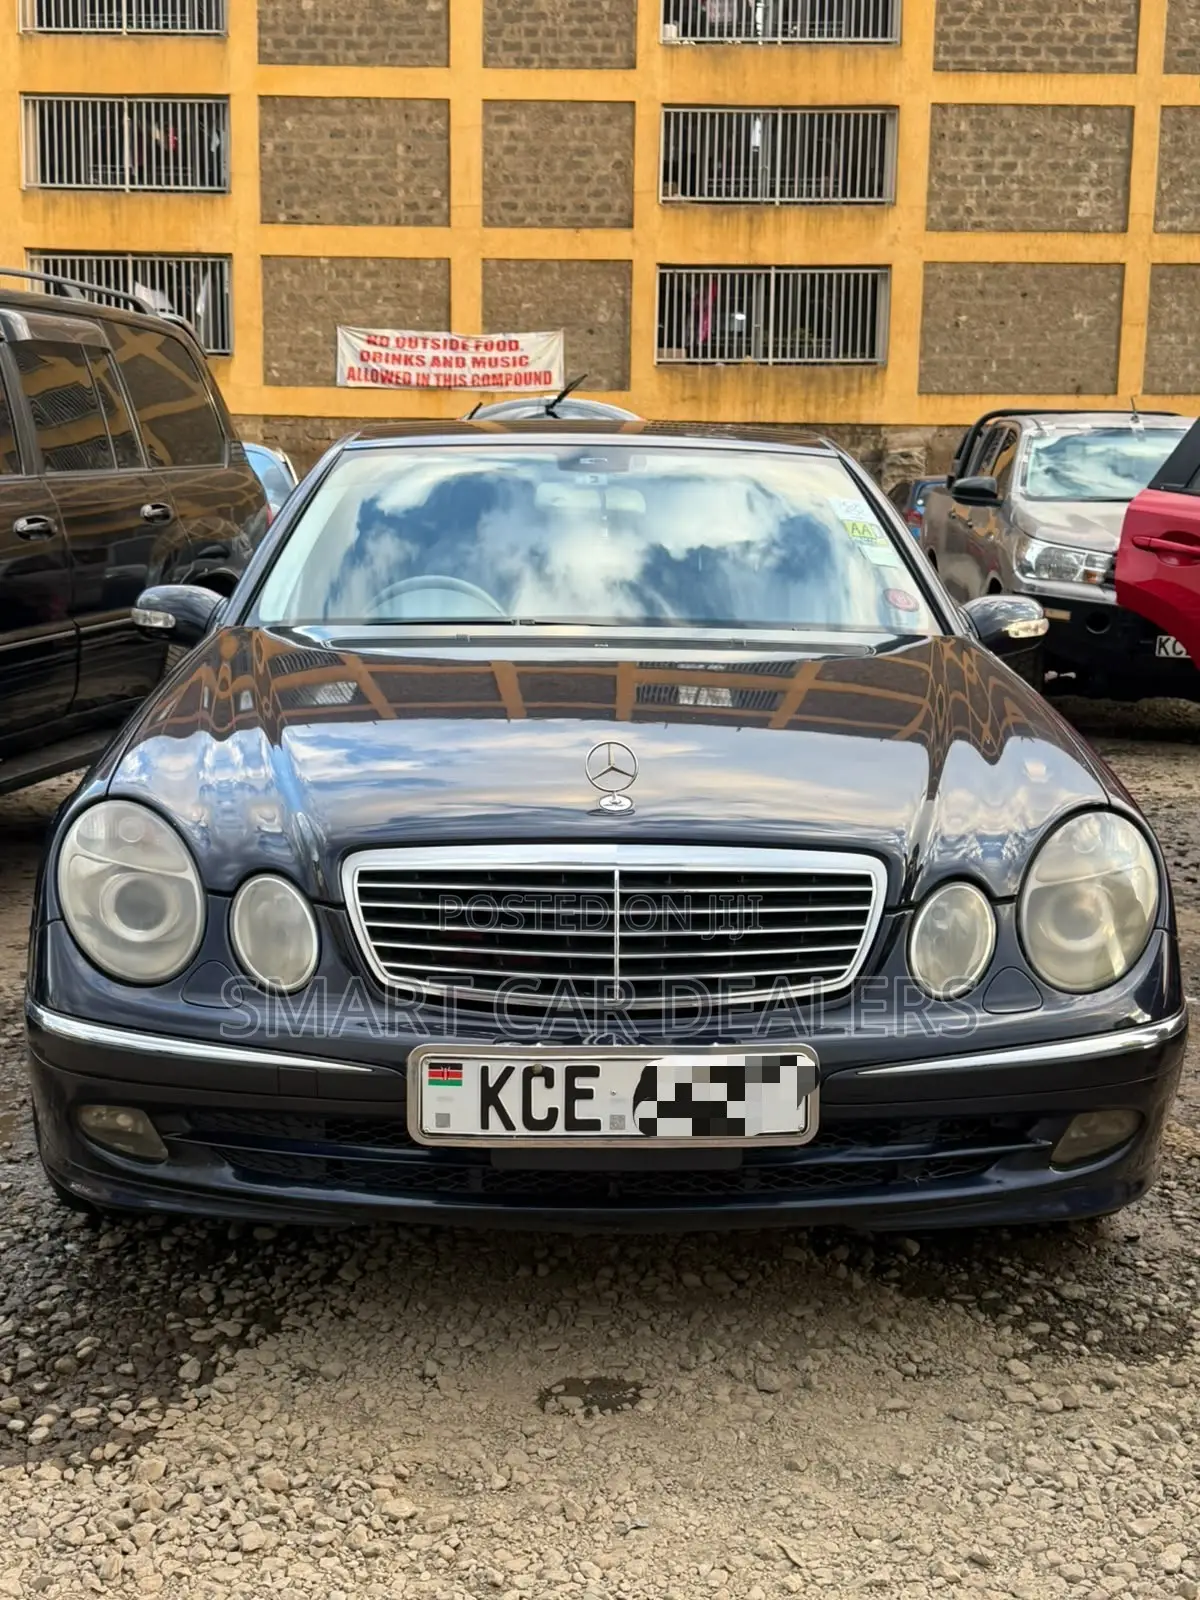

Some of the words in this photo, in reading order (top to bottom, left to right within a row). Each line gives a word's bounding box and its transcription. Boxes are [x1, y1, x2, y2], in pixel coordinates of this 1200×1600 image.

[366, 335, 390, 348] NO
[396, 336, 469, 352] OUTSIDE
[360, 350, 426, 367] DRINKS
[431, 355, 466, 369] AND
[471, 355, 529, 369] MUSIC
[347, 366, 412, 385] ALLOWED
[416, 372, 430, 387] IN
[436, 373, 467, 388] THIS
[471, 370, 553, 388] COMPOUND
[480, 1065, 602, 1132] KCE
